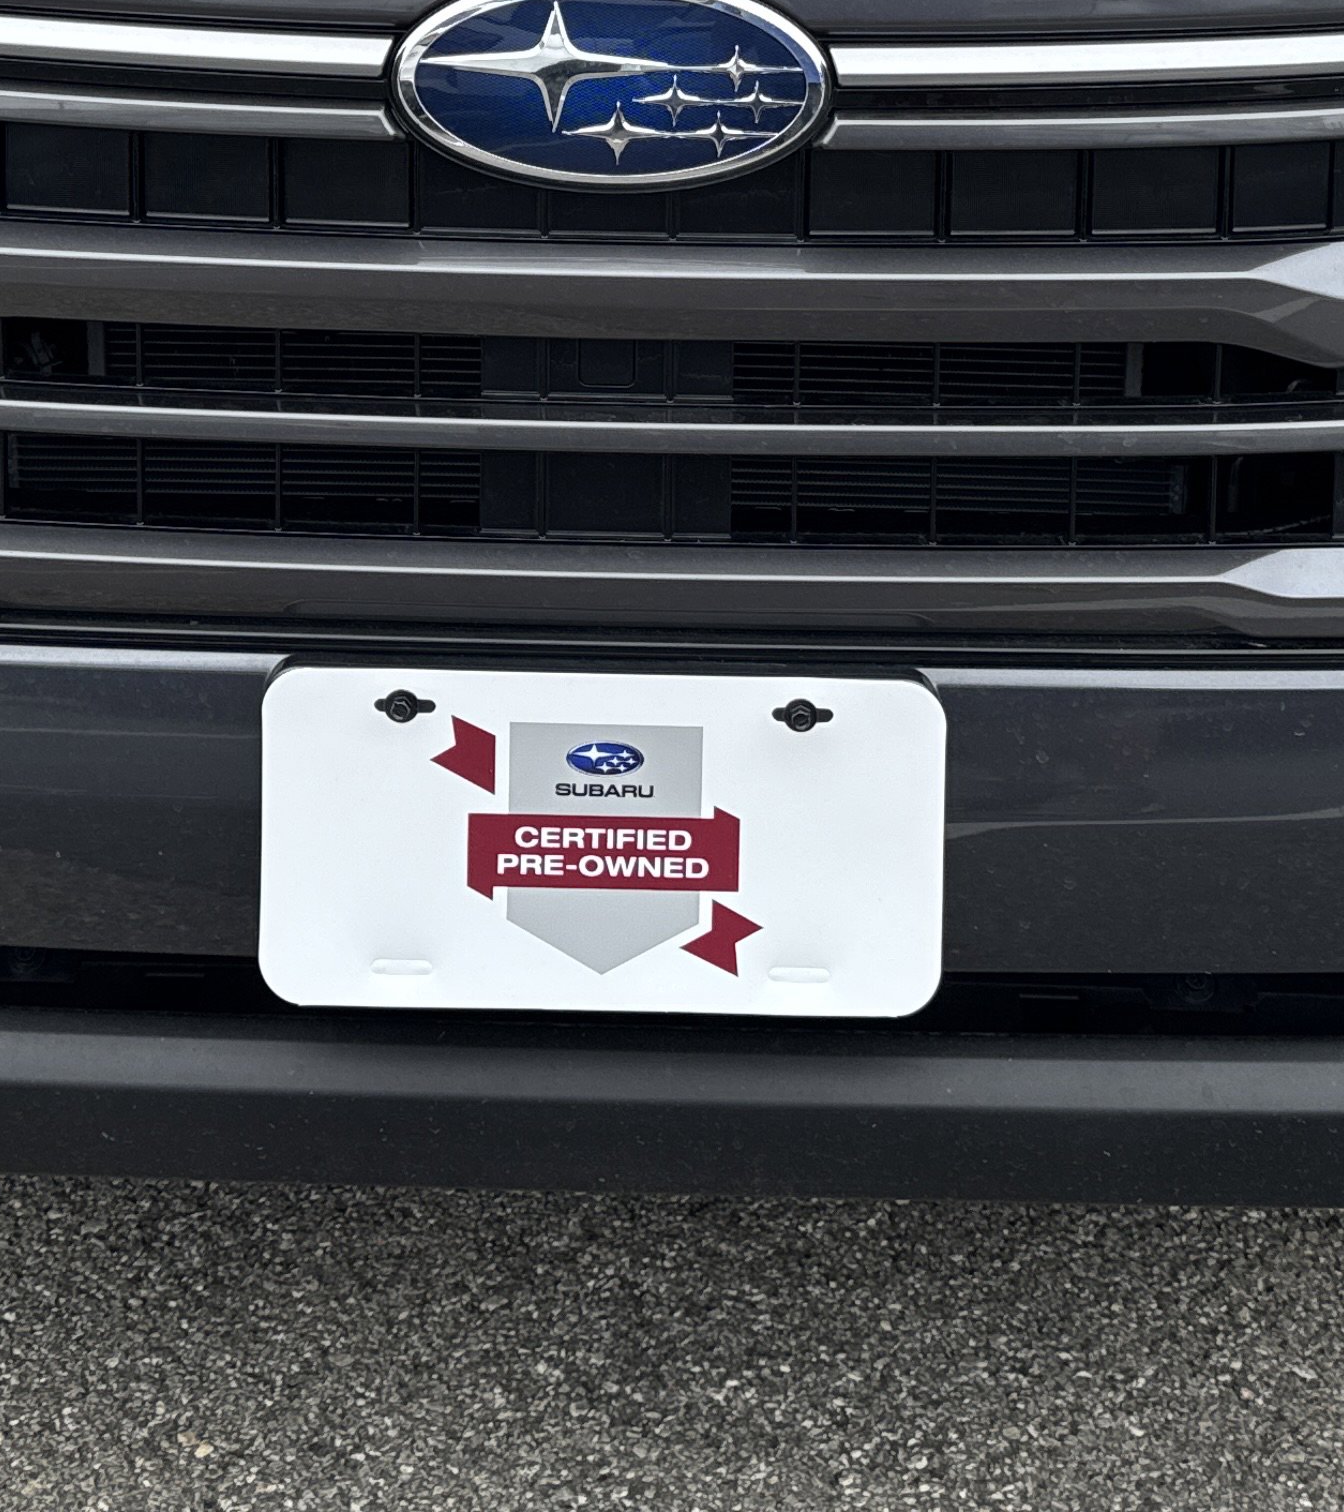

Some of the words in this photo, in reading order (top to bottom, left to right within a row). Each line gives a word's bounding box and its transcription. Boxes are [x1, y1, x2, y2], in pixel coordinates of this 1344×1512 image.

[555, 783, 655, 798] SUBARU
[514, 826, 693, 851] CERTIFIED
[497, 853, 710, 879] PRE-OWNED
